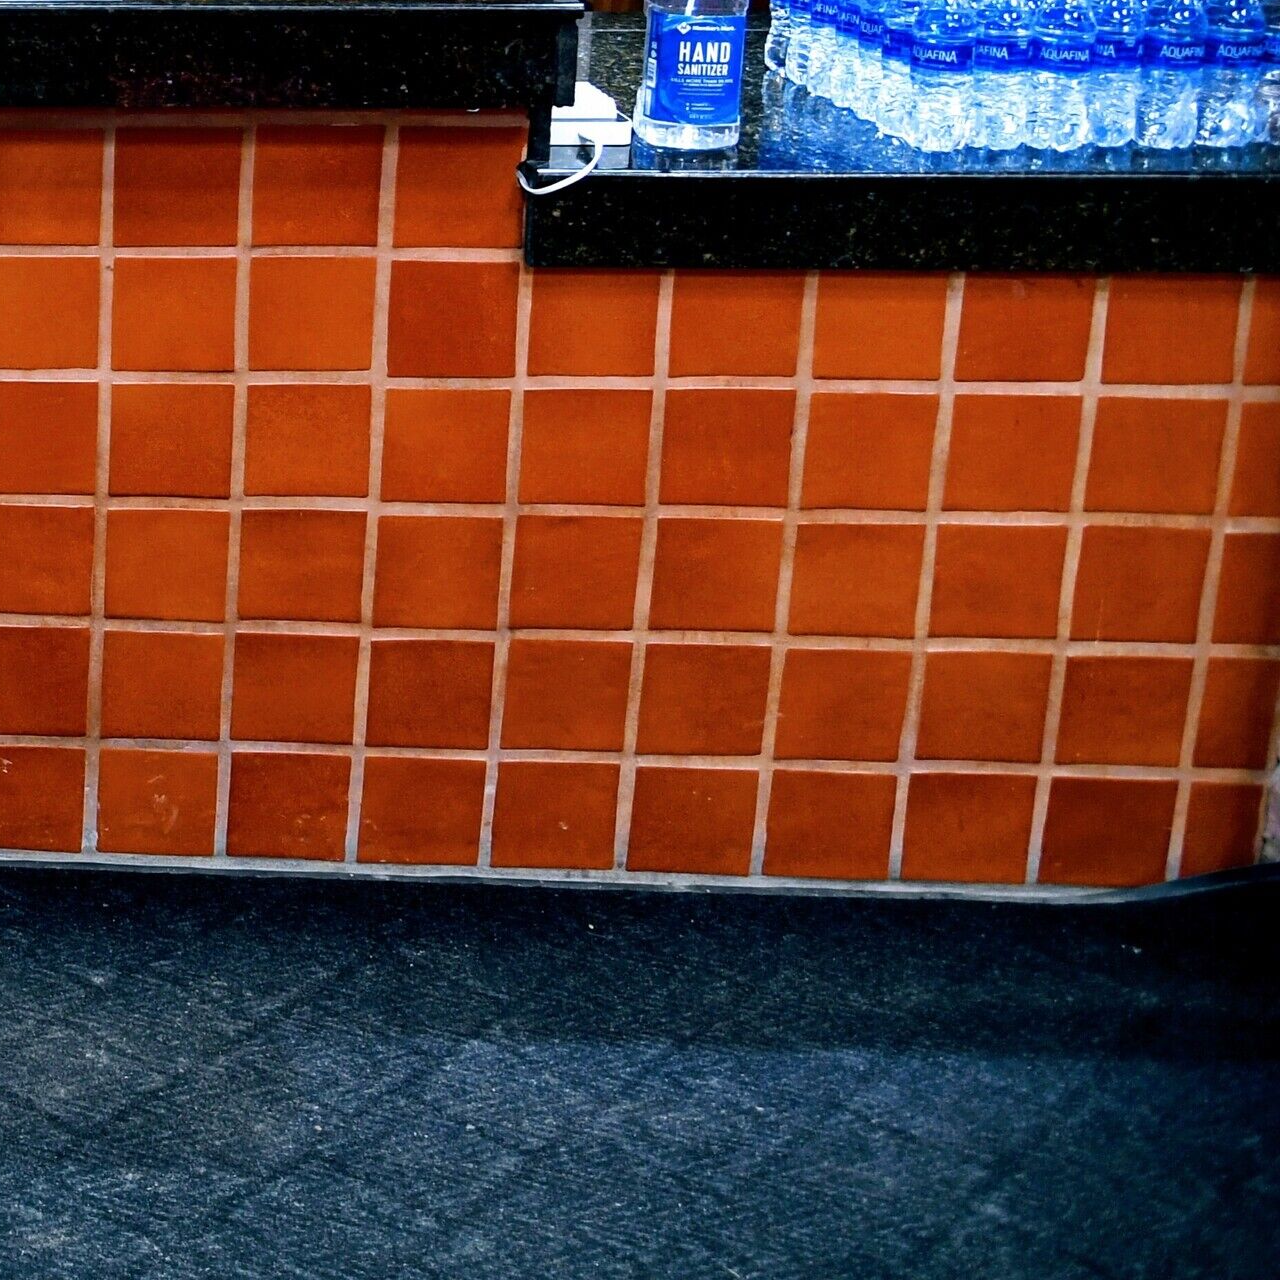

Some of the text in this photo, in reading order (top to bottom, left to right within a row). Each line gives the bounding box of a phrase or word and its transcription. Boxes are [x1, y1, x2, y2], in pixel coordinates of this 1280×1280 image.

[678, 41, 731, 63] HAND
[1161, 45, 1205, 59] AQUAFIN
[677, 63, 728, 76] SANITIZER
